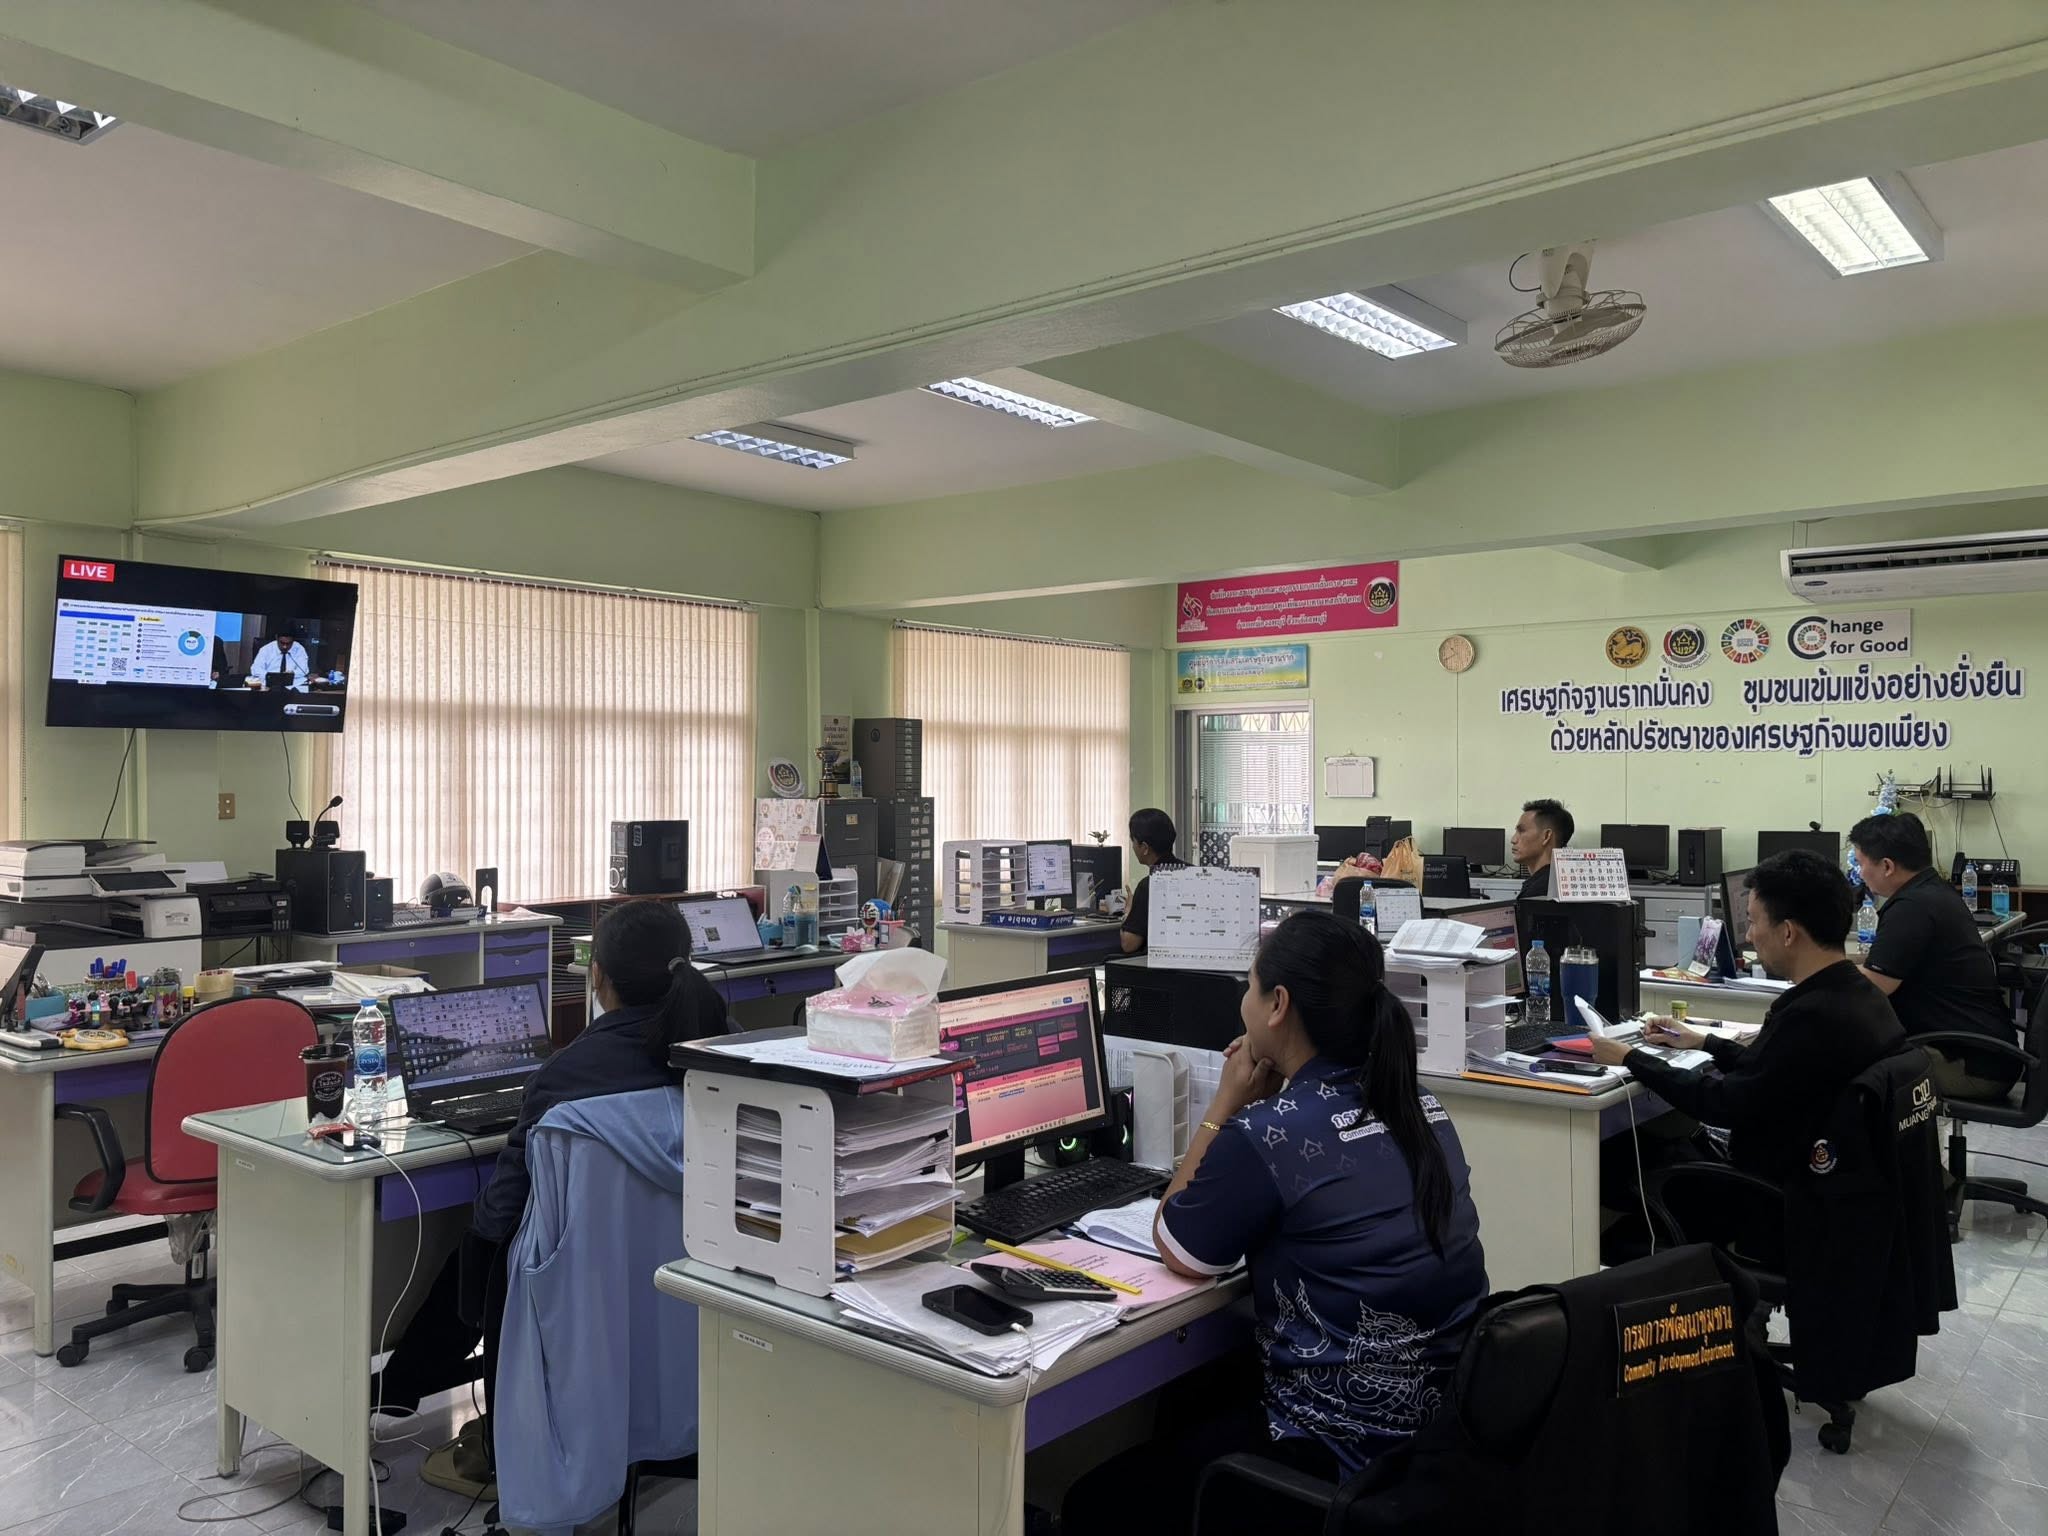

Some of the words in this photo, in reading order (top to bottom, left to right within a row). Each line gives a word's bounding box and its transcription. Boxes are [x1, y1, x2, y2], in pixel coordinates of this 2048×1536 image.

[70, 563, 107, 578] LIVE
[1830, 641, 1855, 654] for
[1859, 637, 1909, 653] Good
[1501, 668, 1711, 717] เศรษฐกิจฐานรากมั่นคง
[1743, 654, 2022, 713] ชุมชนเข้มแข็งอย่างยั่งยืน
[1550, 713, 1948, 756] ด้วยหลักปรัชญาของเศรษฐกิจพอเพียง
[1008, 916, 1037, 925] Double
[1340, 1123, 1384, 1141] Community
[1623, 1303, 1734, 1353] กรมการพัฒนาชุมชน
[1658, 1351, 1701, 1373] Development
[1700, 1340, 1735, 1366] Department
